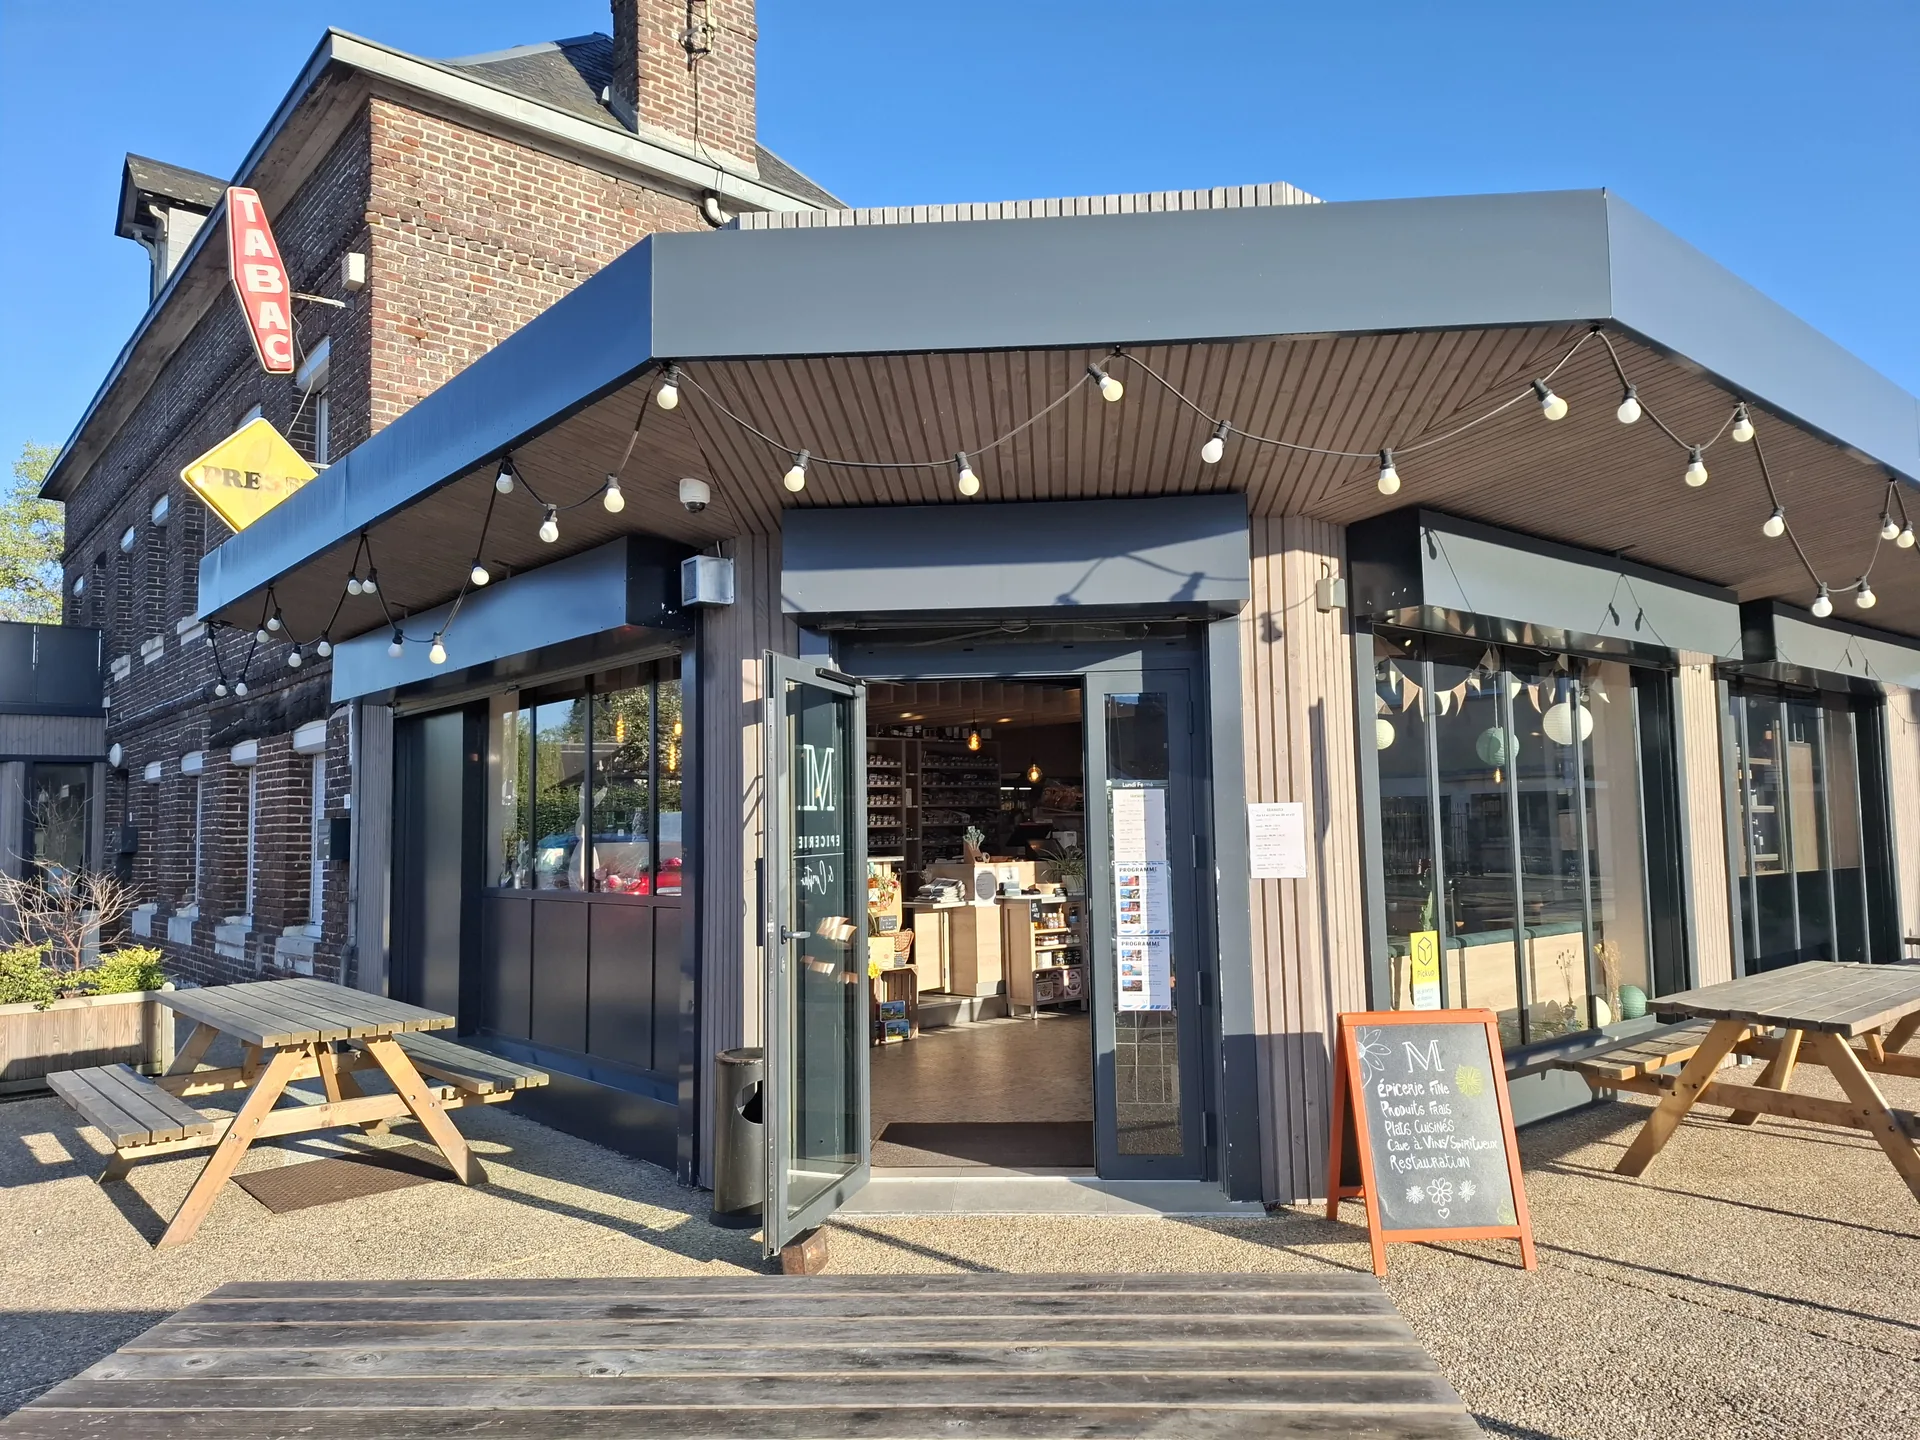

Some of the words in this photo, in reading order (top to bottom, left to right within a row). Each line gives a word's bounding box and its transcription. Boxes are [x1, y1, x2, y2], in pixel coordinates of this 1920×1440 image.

[234, 193, 291, 363] TABAC
[1402, 1040, 1445, 1073] M
[1380, 1100, 1425, 1118] Produits
[1429, 1100, 1452, 1116] Frais
[1384, 1120, 1412, 1137] Plats
[1414, 1118, 1455, 1134] Cuisinés
[1387, 1138, 1410, 1151] Cave
[1413, 1136, 1423, 1150] à
[1389, 1153, 1471, 1174] Restauration
